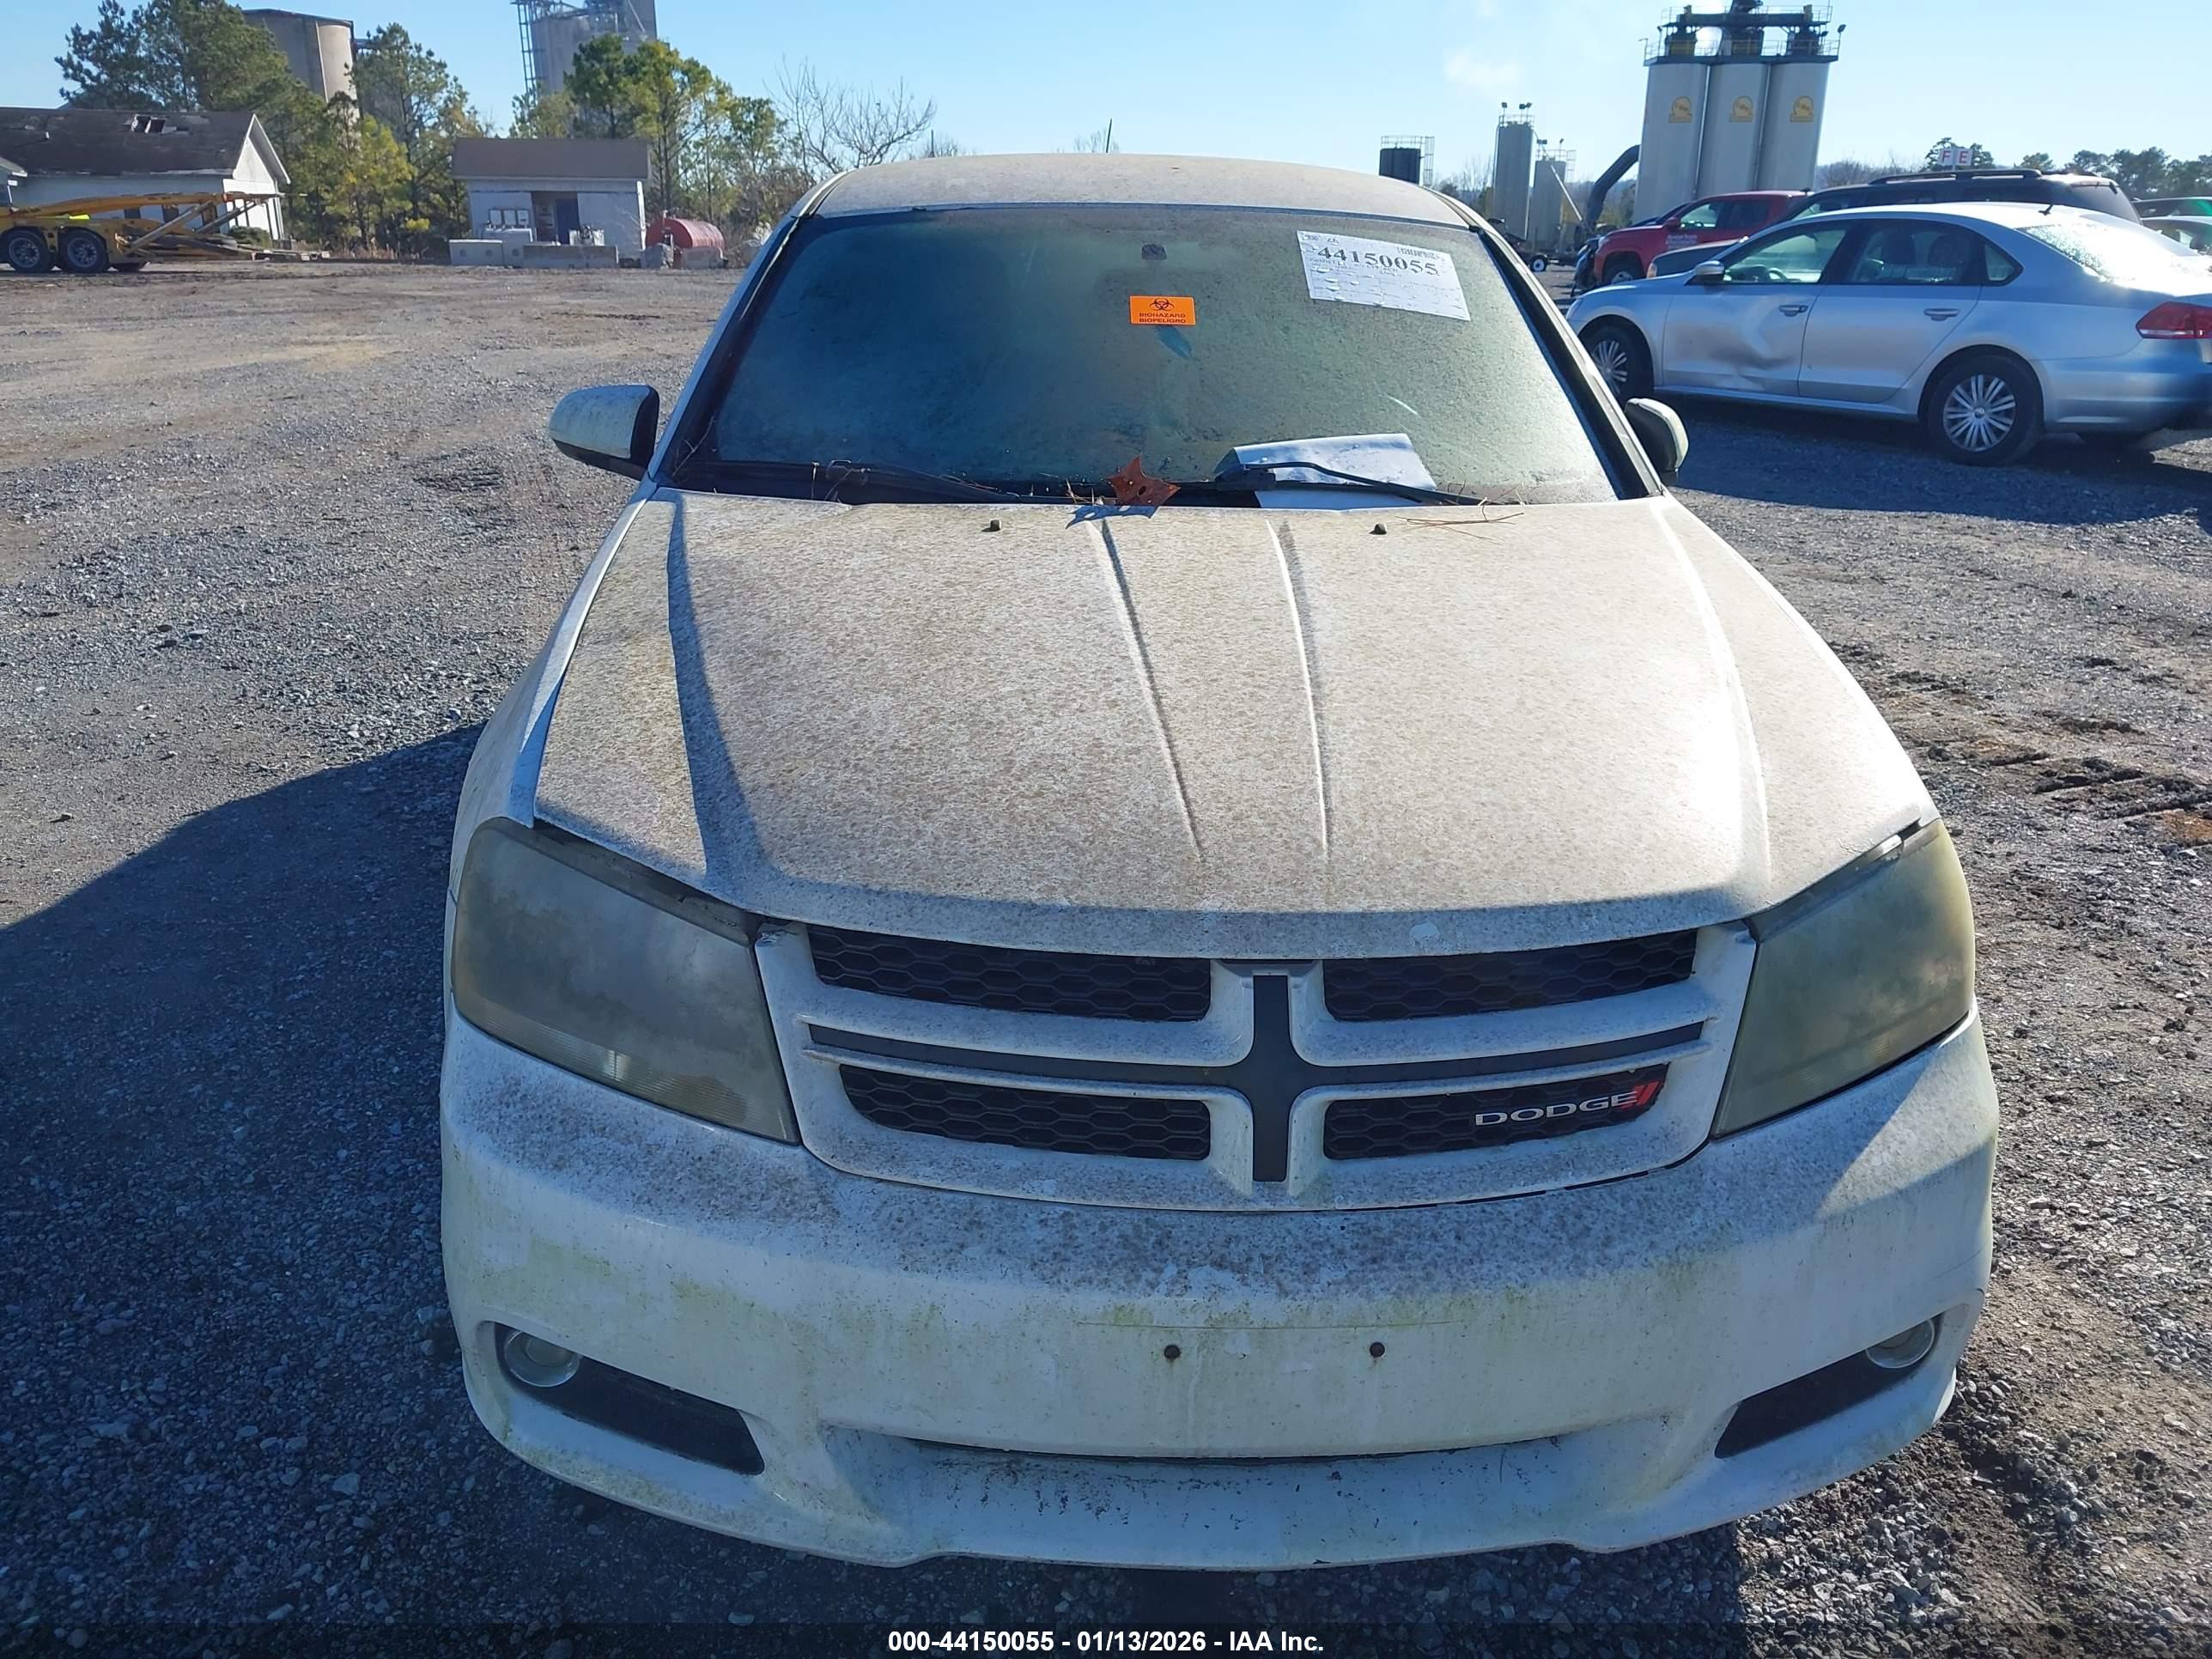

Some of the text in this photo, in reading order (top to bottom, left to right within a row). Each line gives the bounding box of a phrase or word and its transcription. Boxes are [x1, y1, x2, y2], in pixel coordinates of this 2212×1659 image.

[1942, 150, 1969, 163] F E
[1317, 246, 1439, 276] 44150055
[1475, 1090, 1638, 1127] DODGE
